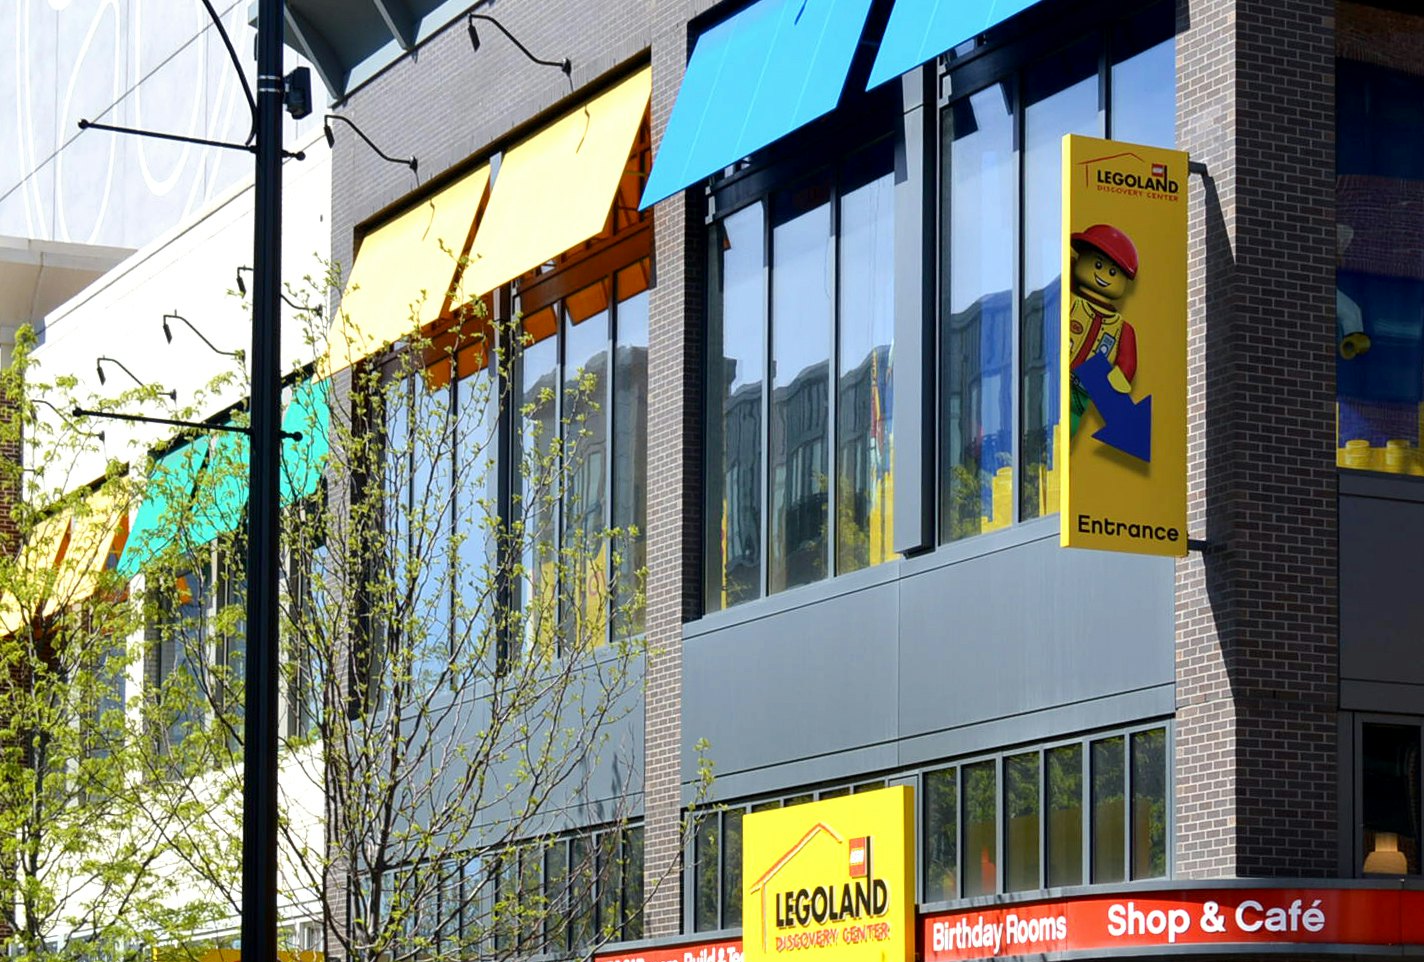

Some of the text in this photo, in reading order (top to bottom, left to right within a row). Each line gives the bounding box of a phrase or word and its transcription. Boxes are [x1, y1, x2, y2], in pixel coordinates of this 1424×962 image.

[1097, 165, 1179, 194] LEGOLAND
[1097, 185, 1179, 202] DISCOVERY CENTER
[1078, 514, 1179, 541] Entrance
[776, 836, 888, 927] LEGOLAND
[776, 922, 889, 952] DISCOVERY CENTER
[932, 899, 1325, 955] Birthday Rooms Shop & Café
